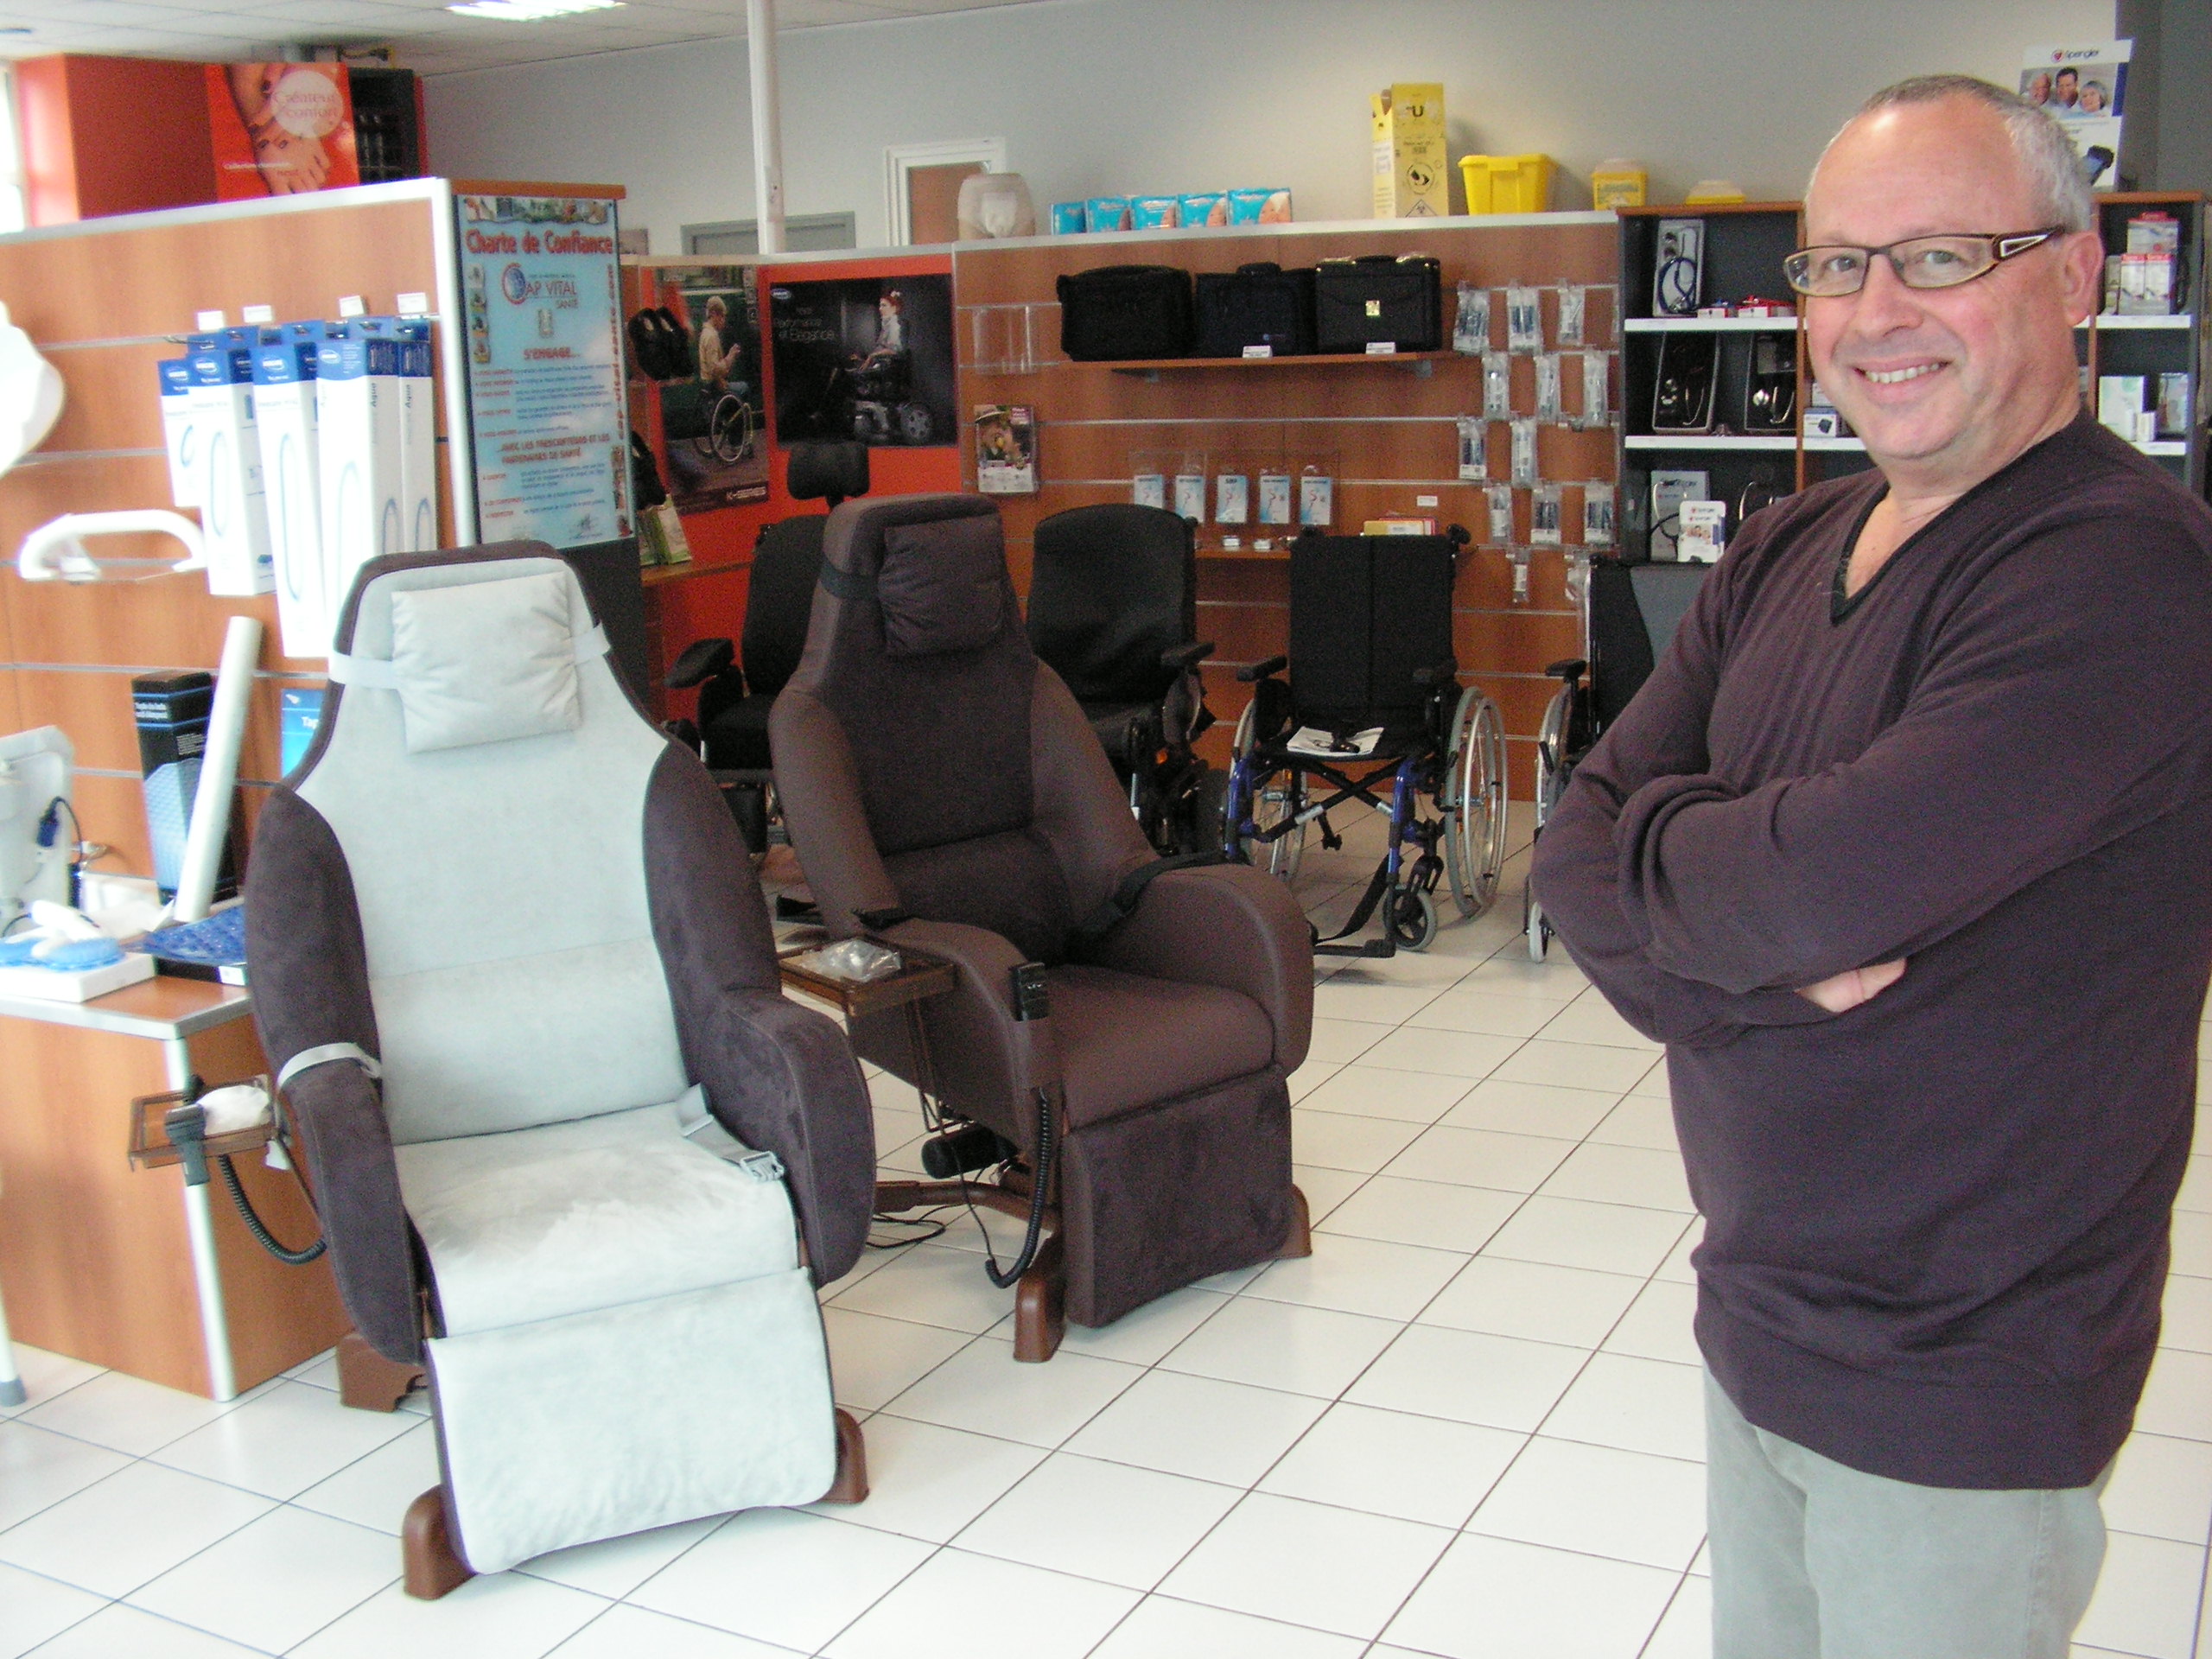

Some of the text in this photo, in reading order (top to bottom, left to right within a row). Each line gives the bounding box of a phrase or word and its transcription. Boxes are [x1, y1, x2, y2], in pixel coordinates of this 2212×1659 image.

[466, 228, 613, 254] Charte de Confiance
[546, 281, 577, 295] VITAL
